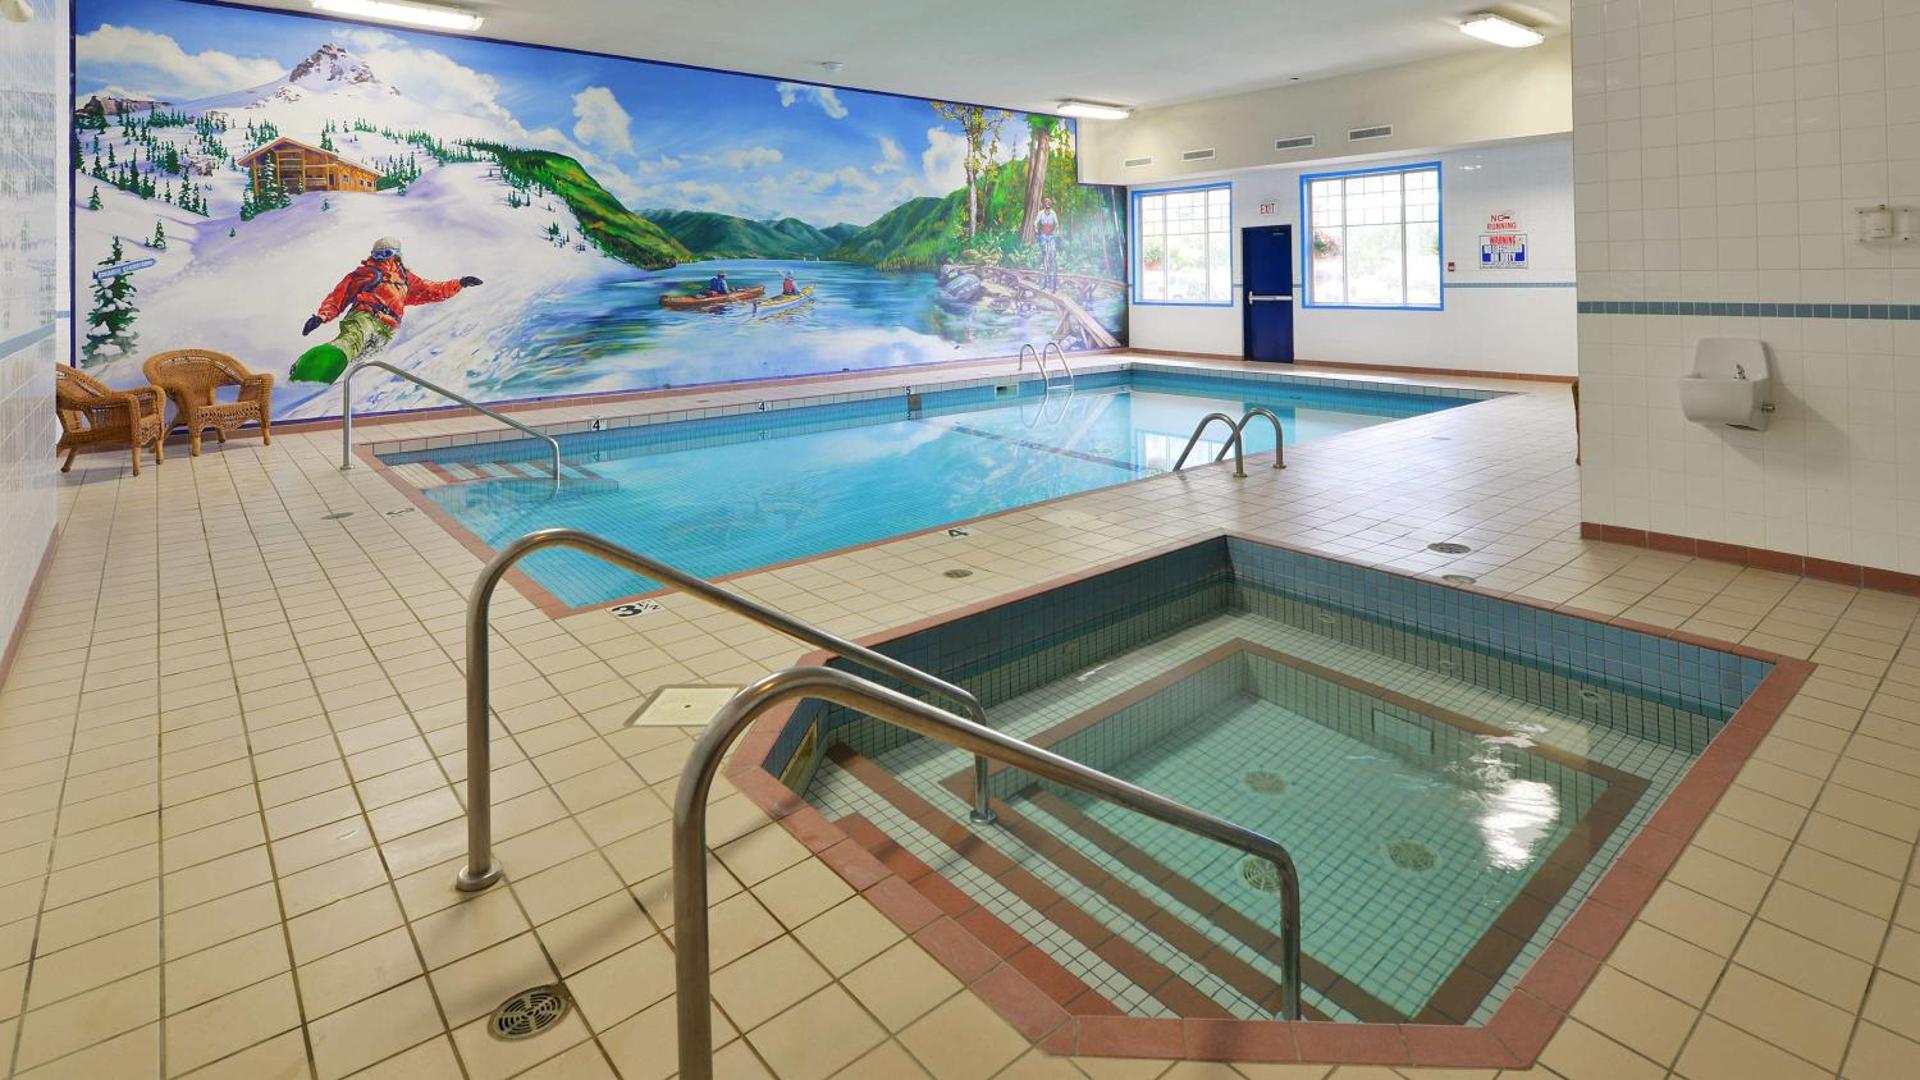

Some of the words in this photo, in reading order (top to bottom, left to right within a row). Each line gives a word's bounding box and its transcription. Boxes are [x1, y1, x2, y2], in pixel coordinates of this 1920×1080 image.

[1260, 203, 1275, 214] EXIT
[1491, 214, 1504, 222] NO
[593, 420, 600, 431] 4
[948, 529, 969, 537] 4
